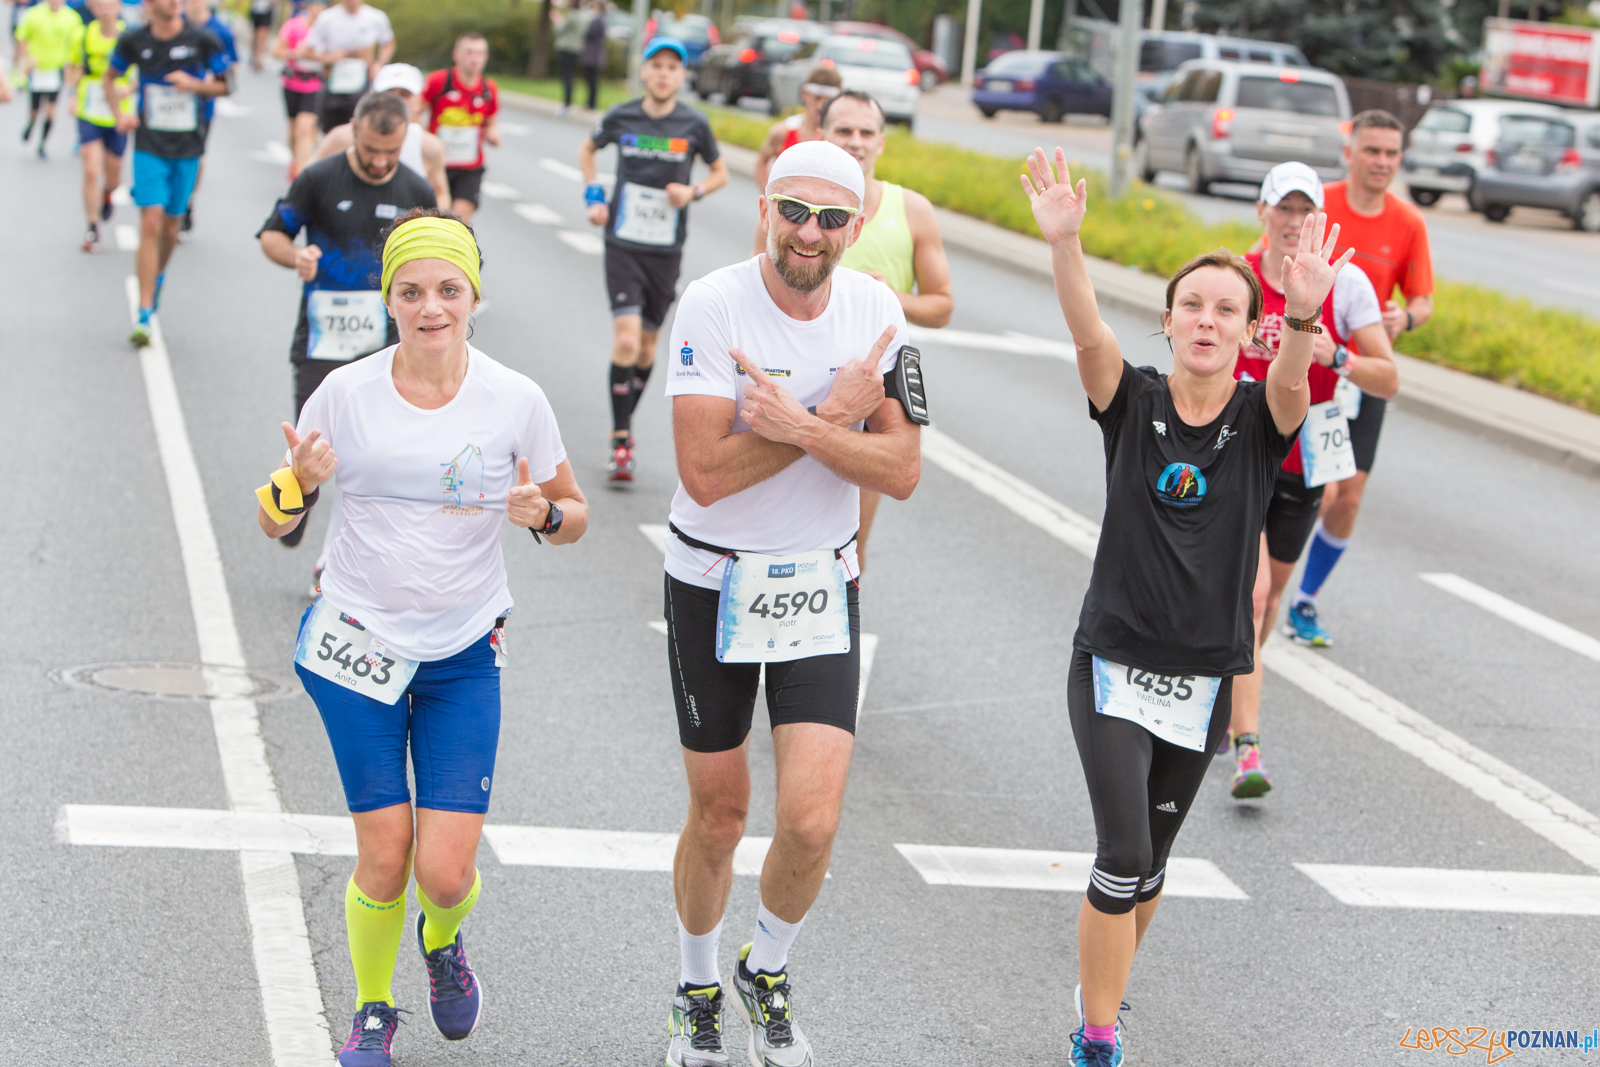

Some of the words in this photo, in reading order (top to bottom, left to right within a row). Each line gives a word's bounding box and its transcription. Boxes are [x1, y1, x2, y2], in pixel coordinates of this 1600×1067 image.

[325, 315, 374, 332] 7304
[781, 566, 794, 575] PKO
[748, 588, 829, 620] 4590
[778, 618, 797, 629] Piotr
[316, 631, 396, 685] 5463
[334, 671, 357, 686] Anita
[688, 695, 700, 721] CRAFT
[1136, 691, 1172, 709] EWELINA
[1156, 804, 1179, 813] adidas
[357, 896, 400, 911] nessi
